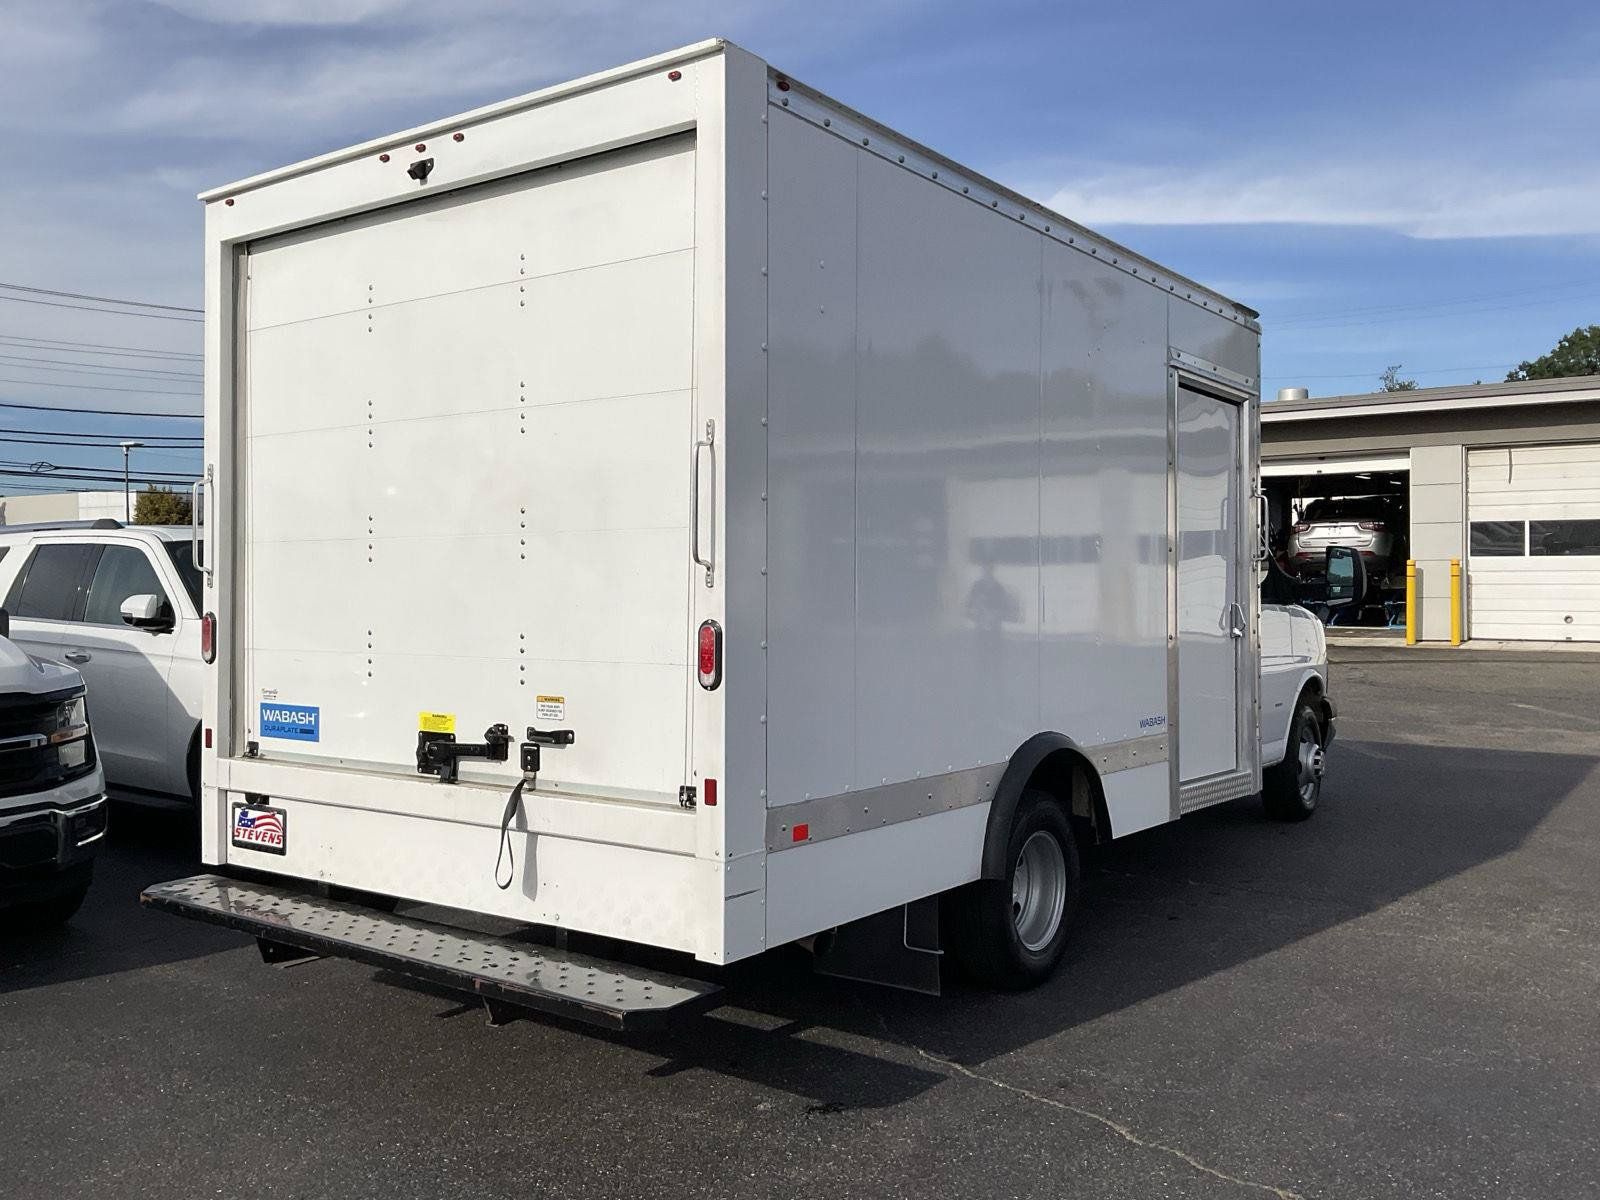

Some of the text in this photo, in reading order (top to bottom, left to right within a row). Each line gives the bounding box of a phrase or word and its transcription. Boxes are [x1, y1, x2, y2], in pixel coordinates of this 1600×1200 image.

[263, 708, 315, 725] WABASH
[1139, 716, 1166, 728] WABASH
[264, 725, 300, 734] DURAPLATE
[235, 827, 283, 845] STEVENS
